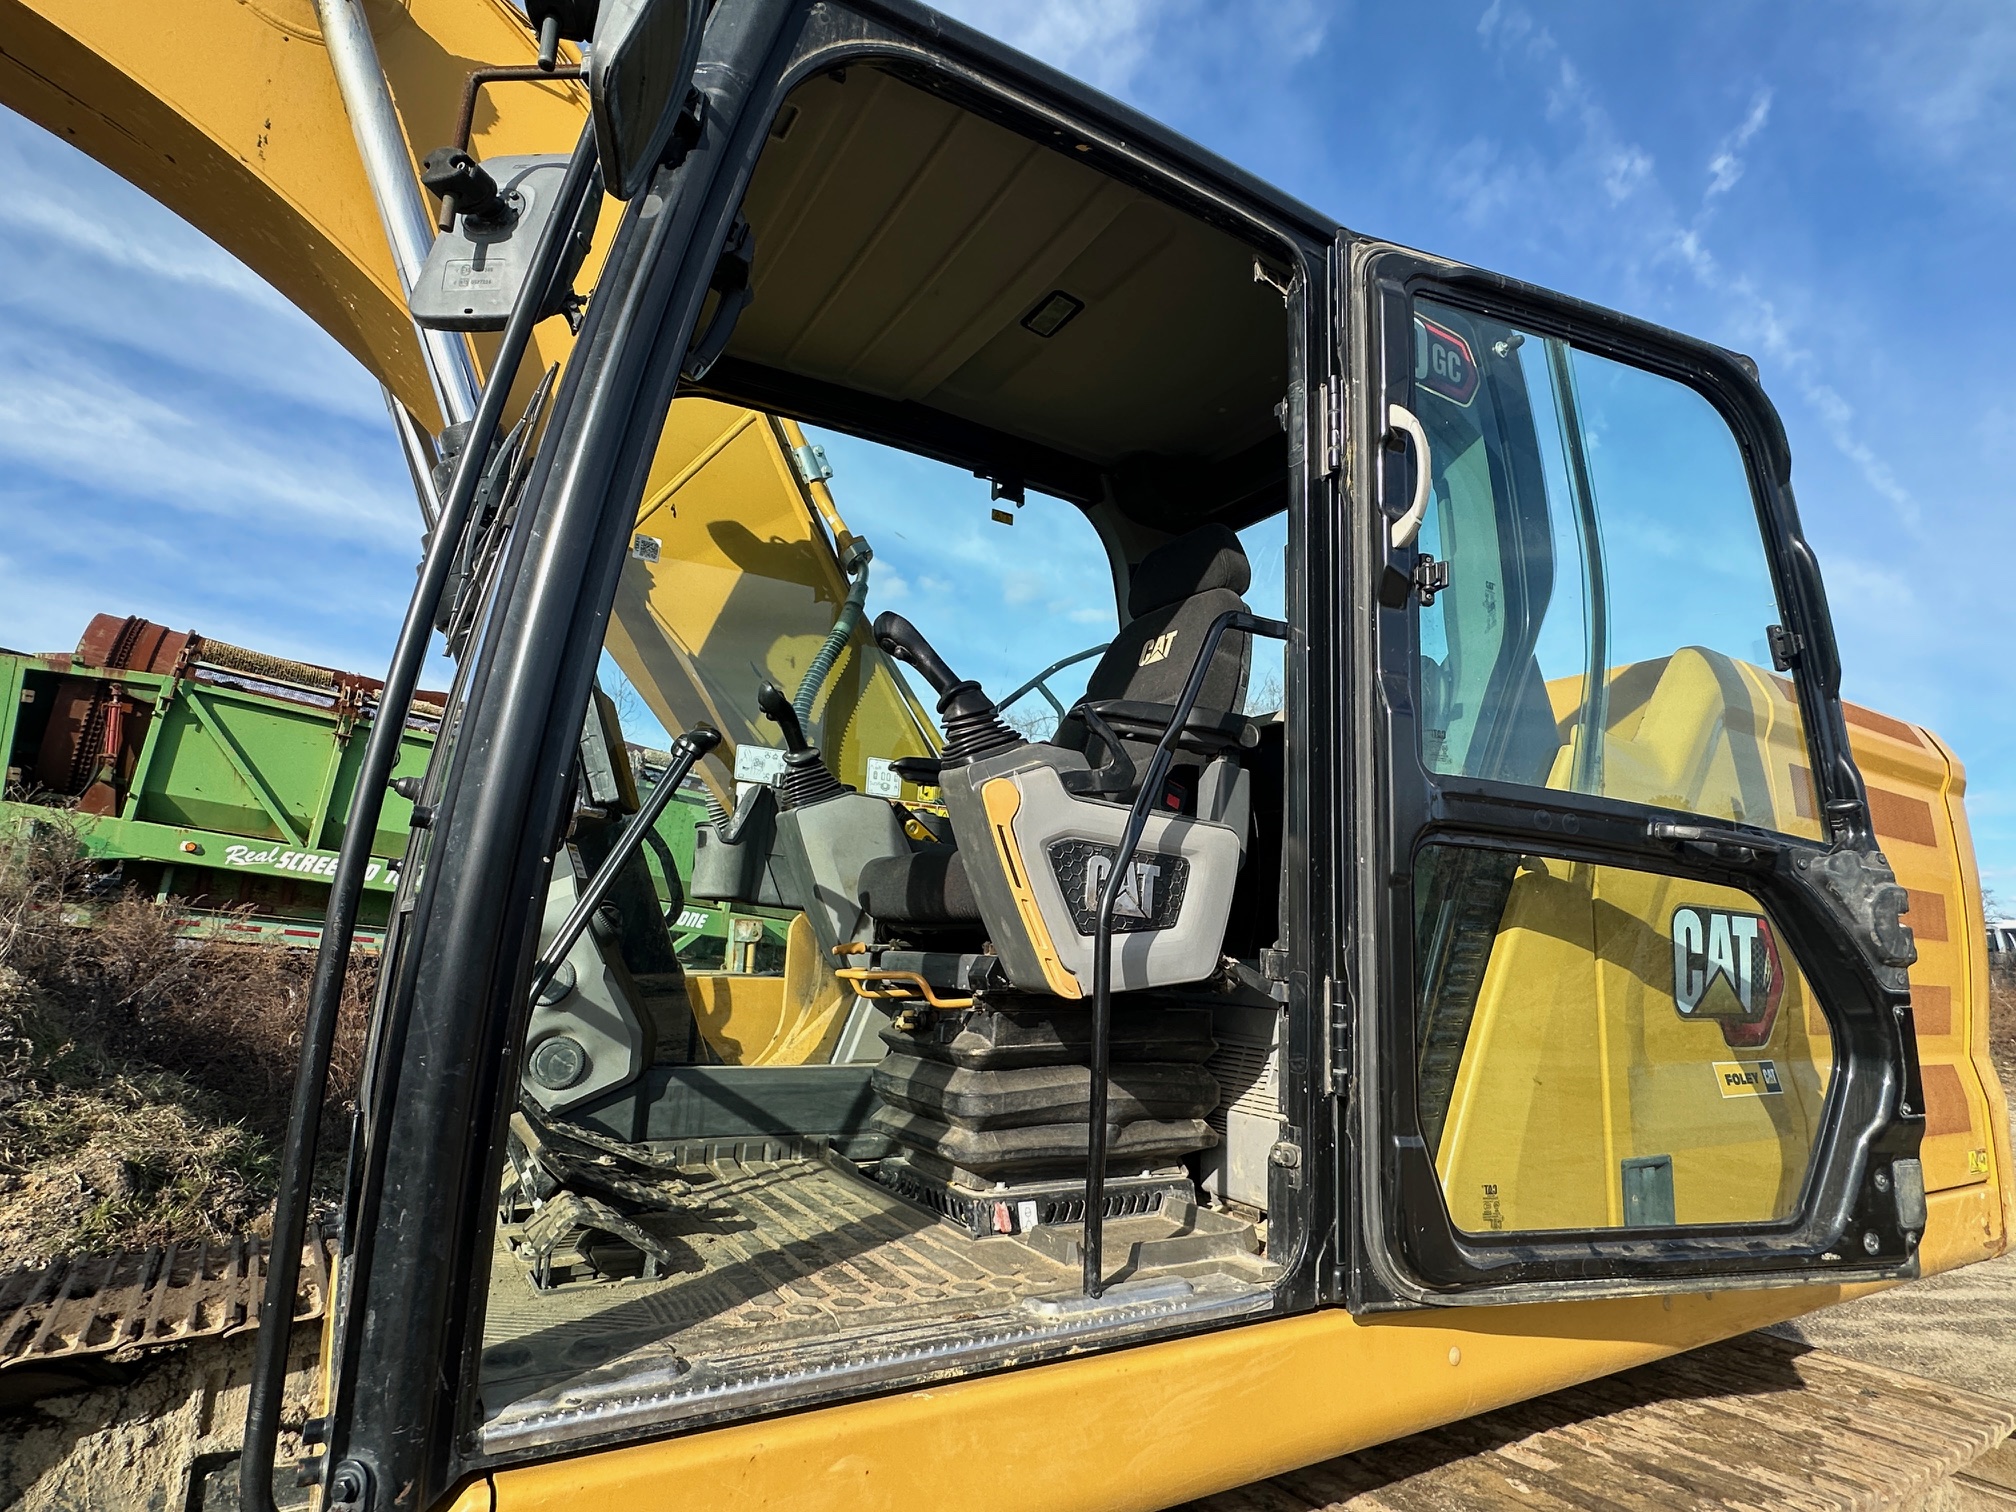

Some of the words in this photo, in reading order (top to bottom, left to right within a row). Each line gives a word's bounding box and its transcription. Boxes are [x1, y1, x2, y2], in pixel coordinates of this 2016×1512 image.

[1432, 343, 1461, 383] GC
[1139, 630, 1178, 667] CAT
[225, 843, 280, 866] Real
[274, 851, 381, 881] SCREED
[1085, 855, 1161, 919] CAT
[1673, 908, 1758, 1014] CAT
[1724, 1072, 1759, 1086] FOLEY
[1762, 1068, 1778, 1084] CAT
